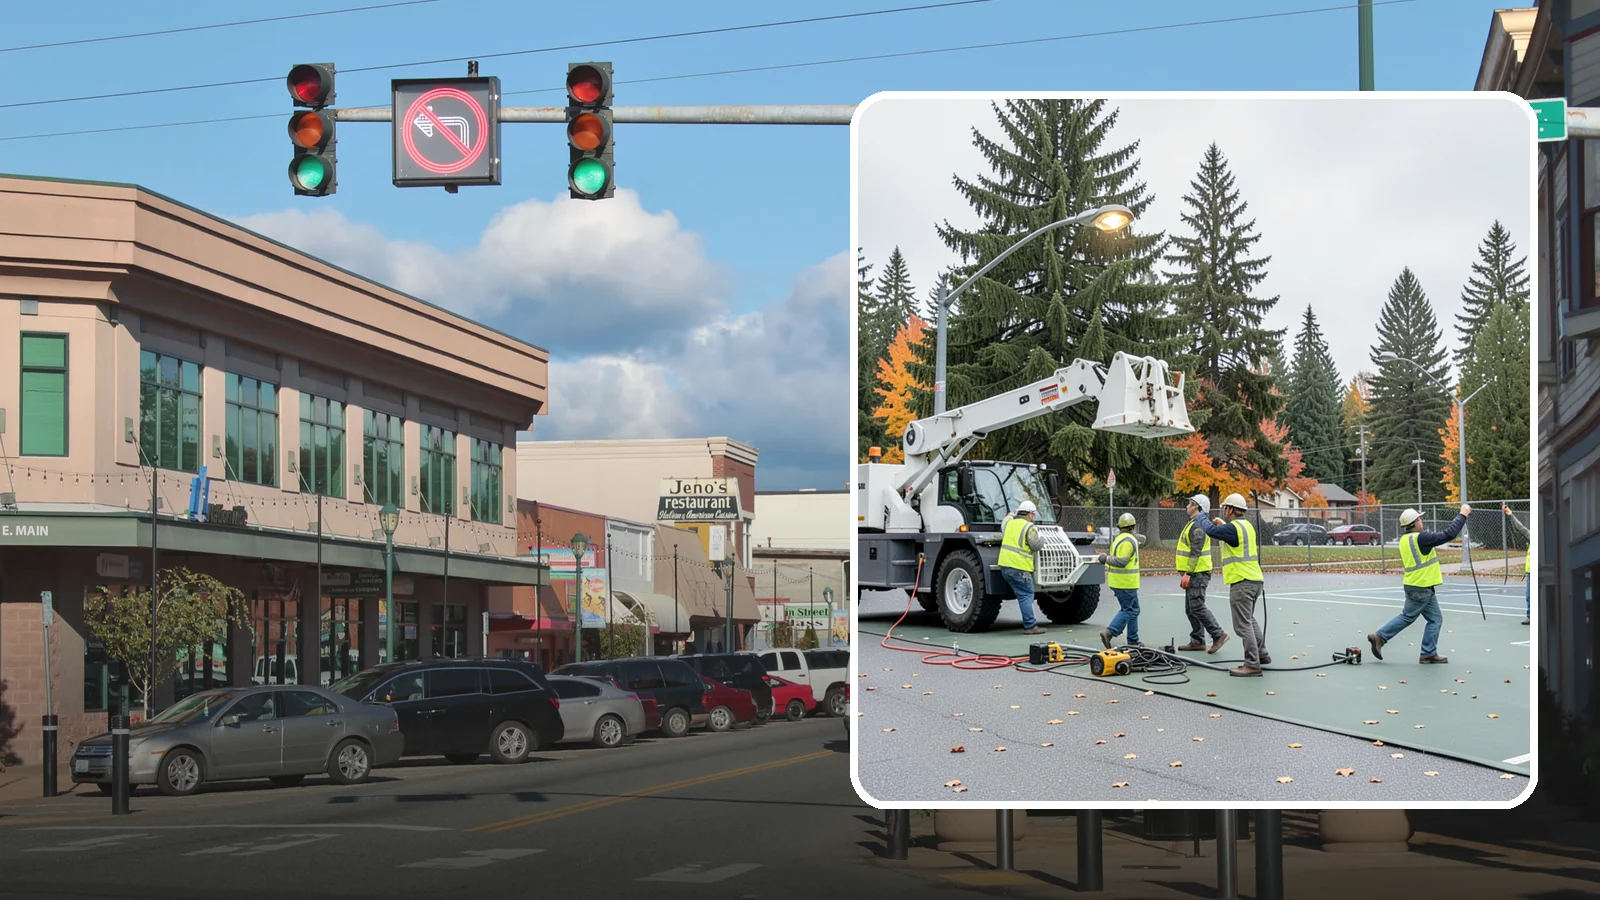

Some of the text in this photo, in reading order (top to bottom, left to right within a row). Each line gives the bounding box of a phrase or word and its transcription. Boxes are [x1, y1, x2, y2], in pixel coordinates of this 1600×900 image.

[669, 480, 728, 495] Jeno's
[665, 496, 731, 509] restaurant
[658, 510, 682, 520] Italian
[686, 510, 715, 519] American
[715, 509, 738, 519] Cuisine
[2, 525, 49, 536] E. MAIN
[785, 607, 795, 617] in
[797, 607, 829, 617] Street
[790, 619, 824, 627] lass
